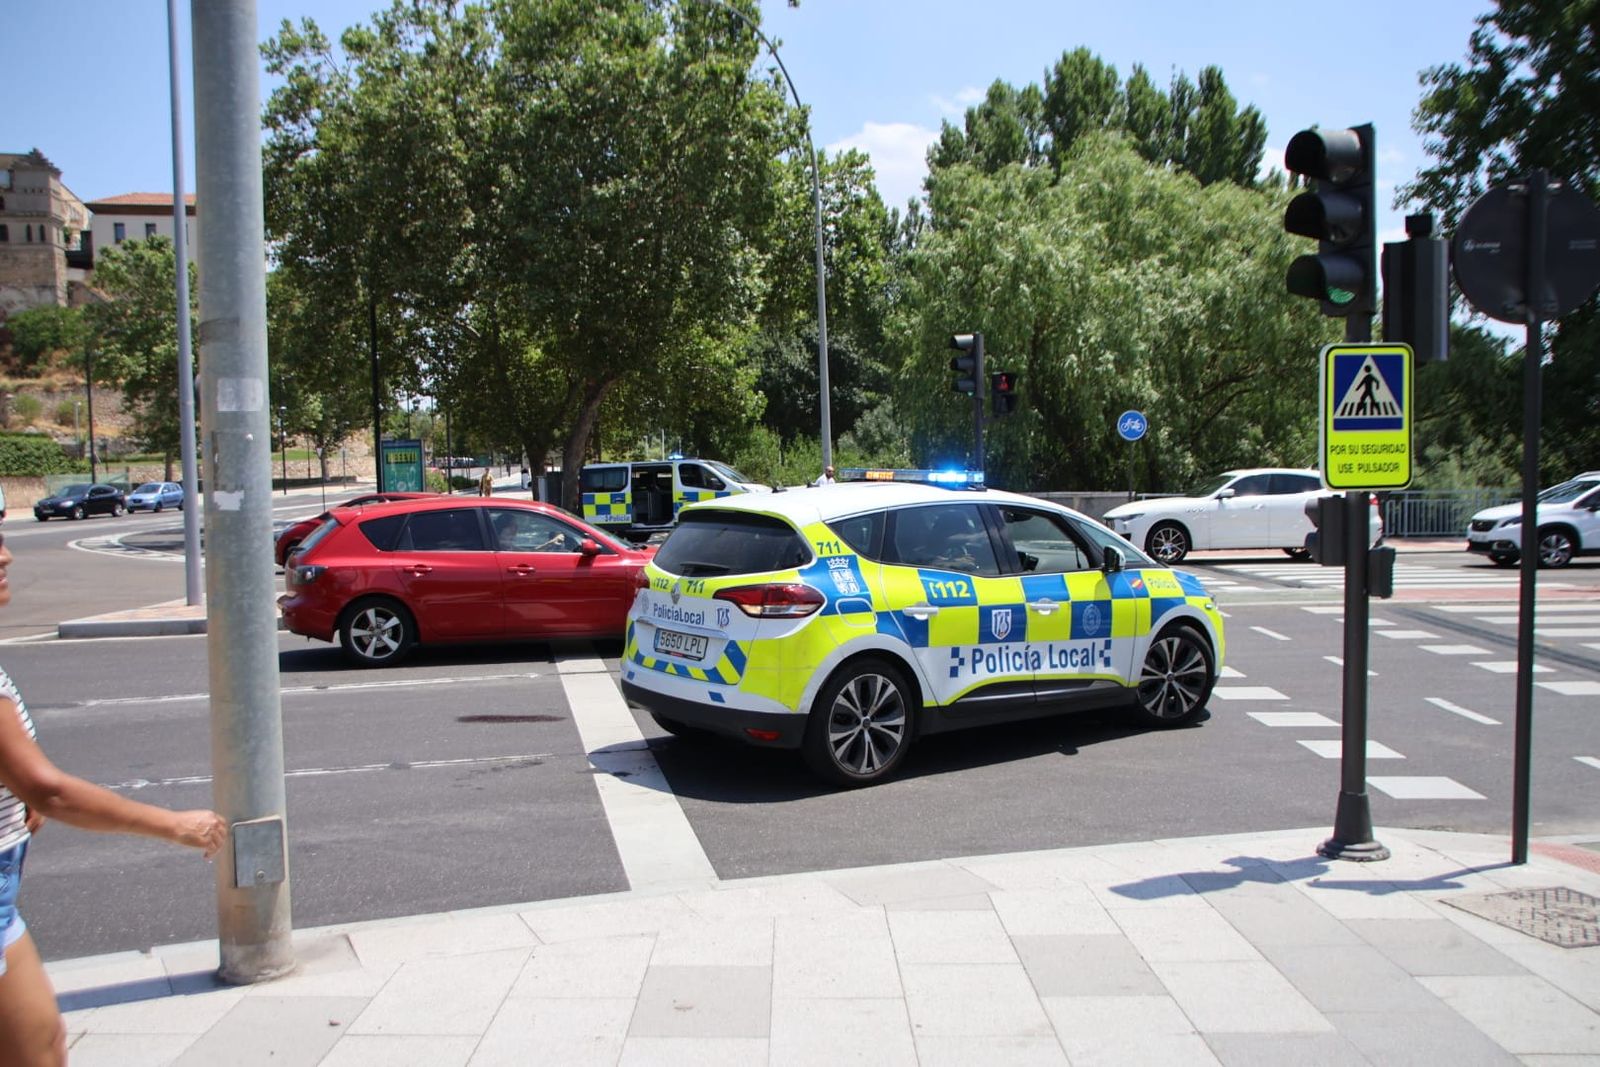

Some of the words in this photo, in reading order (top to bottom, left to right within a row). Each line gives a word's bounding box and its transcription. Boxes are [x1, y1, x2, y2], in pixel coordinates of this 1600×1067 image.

[1330, 444, 1346, 455] POR
[1348, 444, 1359, 455] SU
[1360, 443, 1406, 455] SEGURIDAD
[1337, 462, 1354, 473] USE
[1358, 462, 1400, 473] PULSADOR
[816, 540, 841, 555] 711
[656, 577, 669, 590] 112
[686, 580, 705, 594] 711
[936, 579, 971, 600] 112
[660, 630, 683, 650] 5650
[683, 636, 703, 655] LPL
[971, 643, 1041, 676] Policía
[1048, 642, 1097, 669] Local
